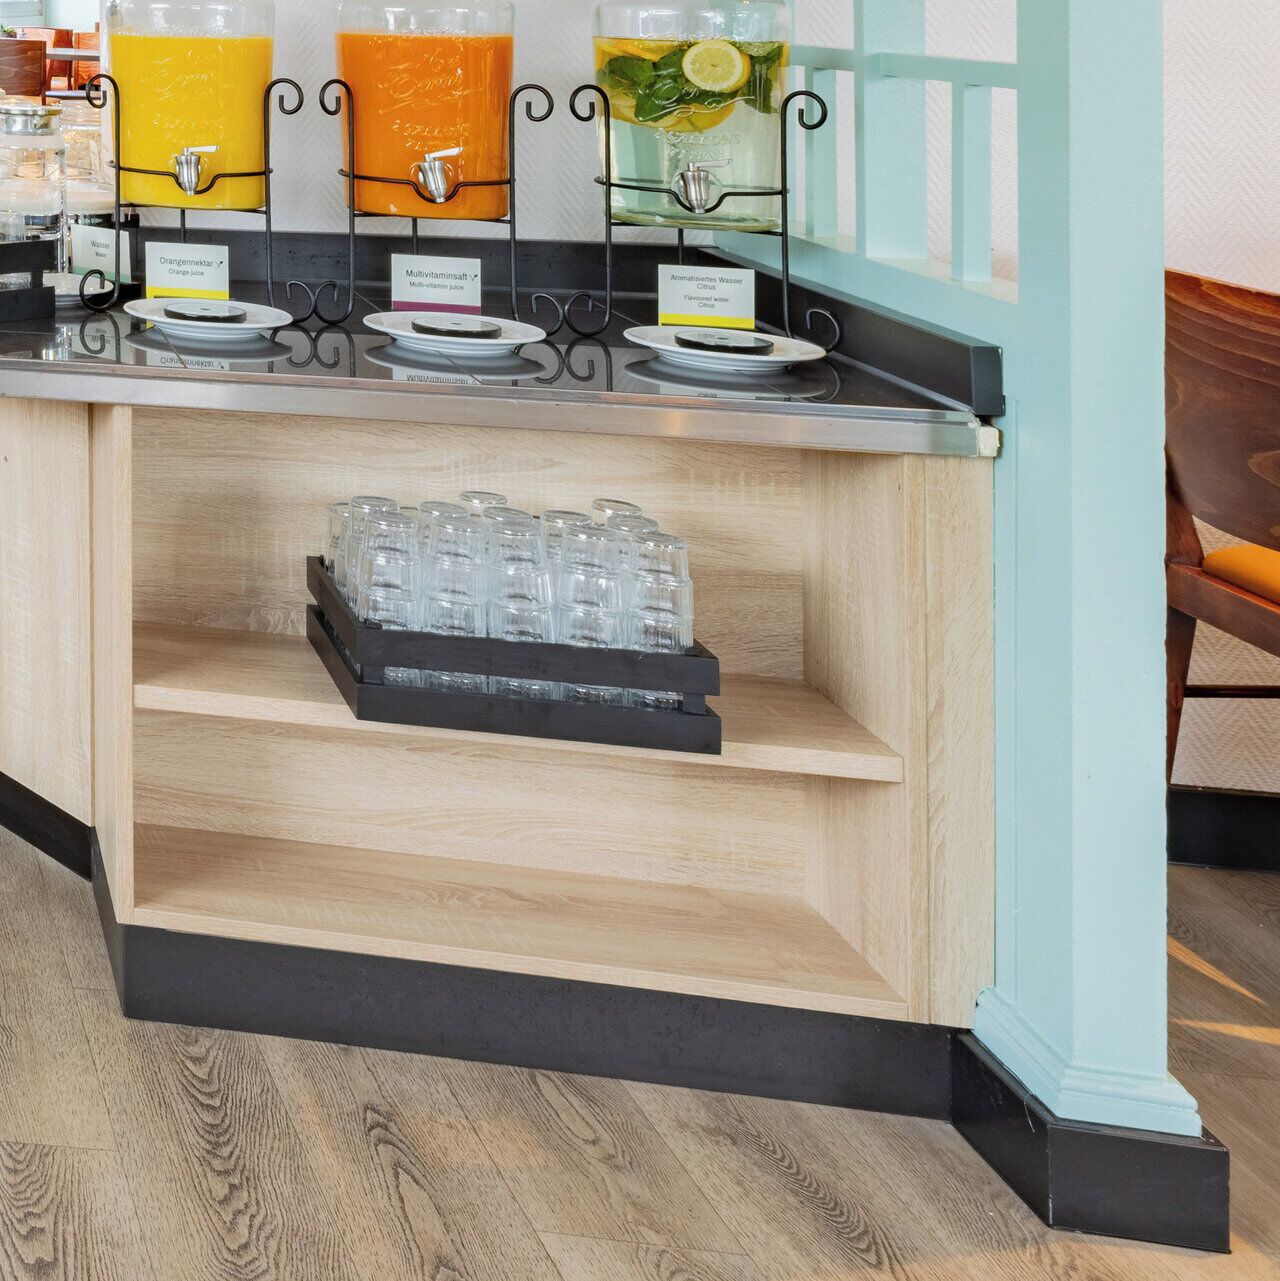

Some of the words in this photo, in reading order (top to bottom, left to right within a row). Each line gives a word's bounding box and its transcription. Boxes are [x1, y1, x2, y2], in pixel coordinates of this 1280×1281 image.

[90, 239, 111, 250] Wasser
[159, 256, 213, 268] Orangennektar
[168, 268, 189, 277] Orange
[190, 269, 204, 277] juice
[405, 269, 468, 281] Multivitaminsaft
[670, 274, 717, 283] Aromatisiertes
[718, 276, 743, 285] Wasser
[409, 281, 448, 290] Multi-vitamin
[696, 282, 716, 291] Citrus
[684, 294, 713, 302] Flavoured
[697, 301, 715, 309] Citrus
